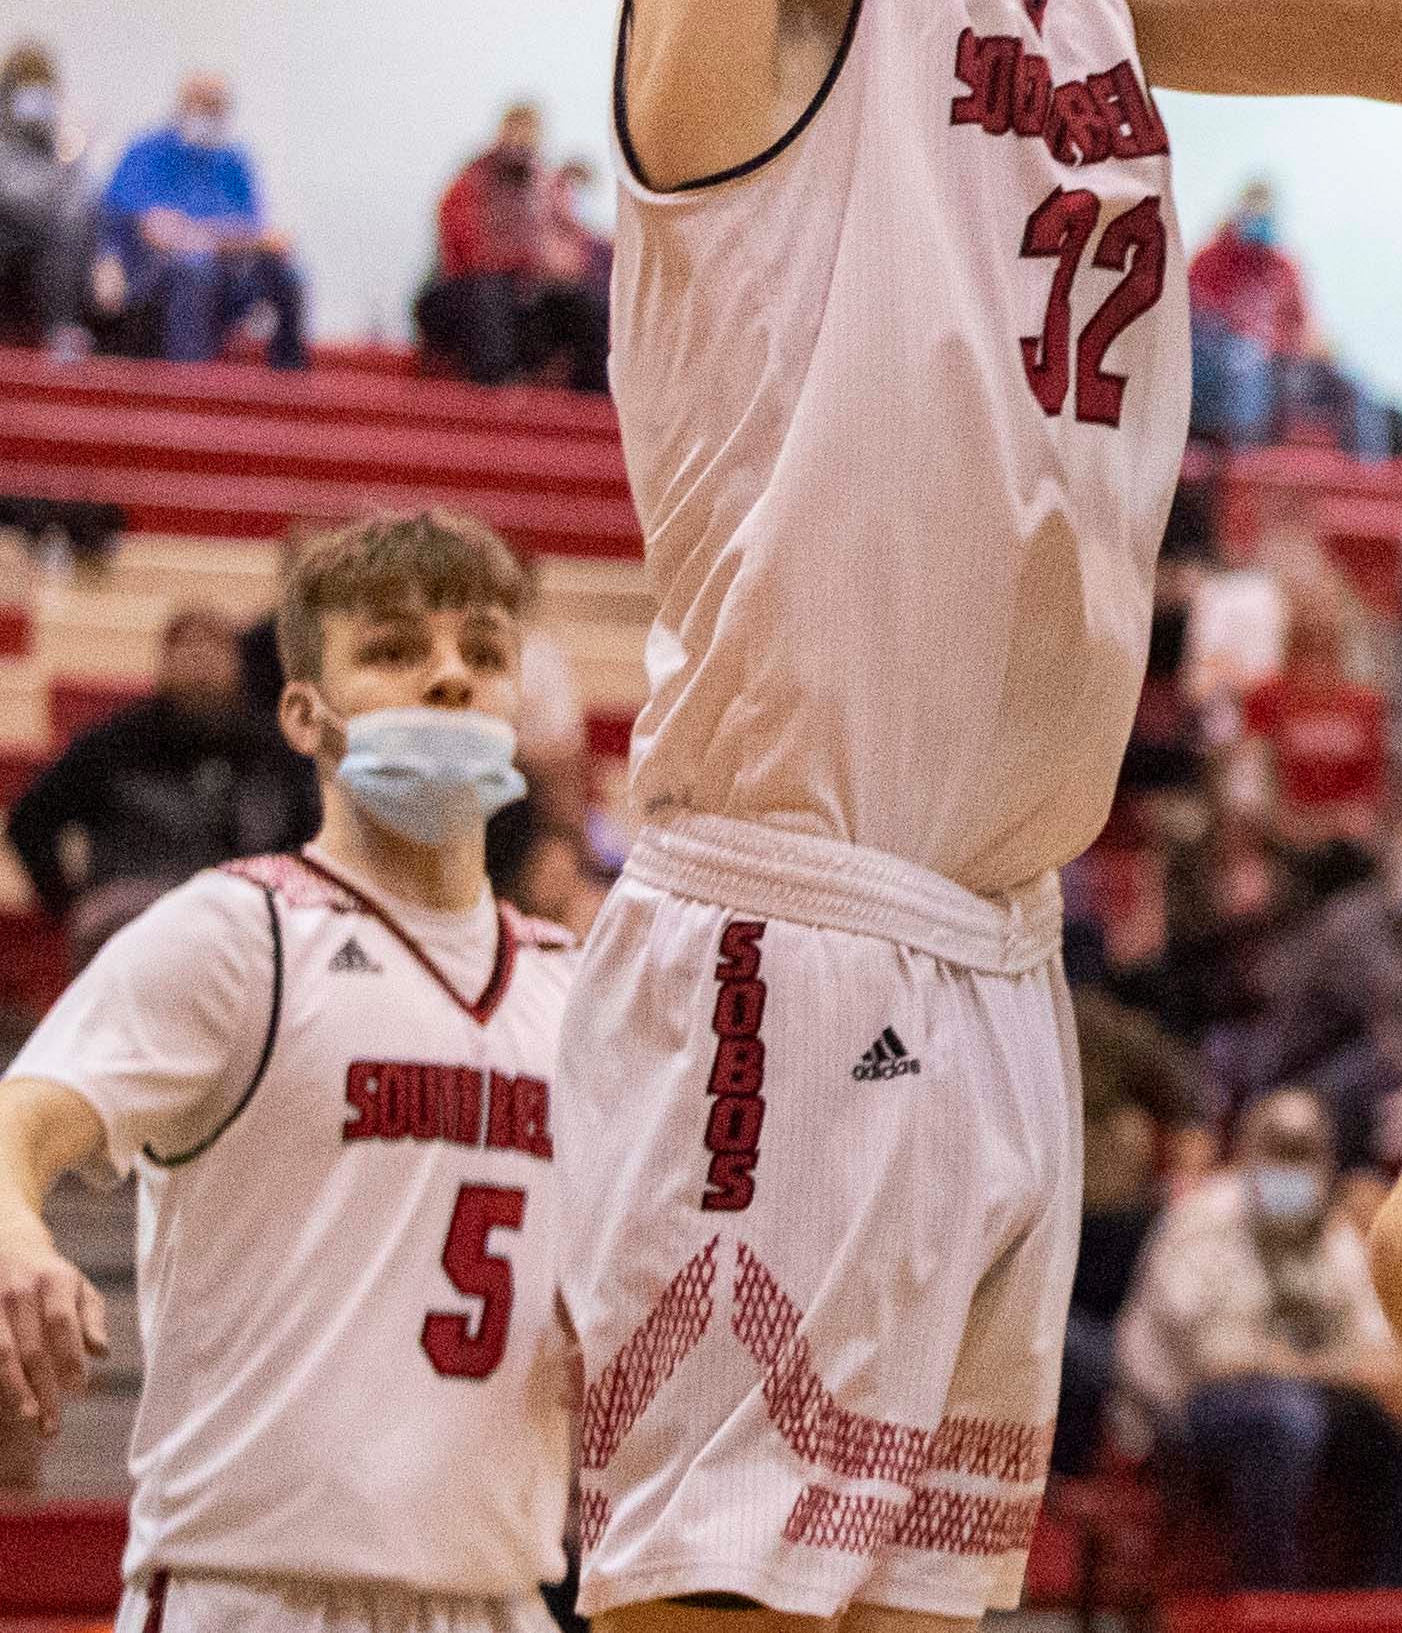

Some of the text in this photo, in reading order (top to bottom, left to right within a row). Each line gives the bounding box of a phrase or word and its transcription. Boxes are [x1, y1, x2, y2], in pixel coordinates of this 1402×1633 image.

[1019, 186, 1167, 428] 32
[701, 920, 767, 1212] SOBOS
[420, 1181, 527, 1382] 5
